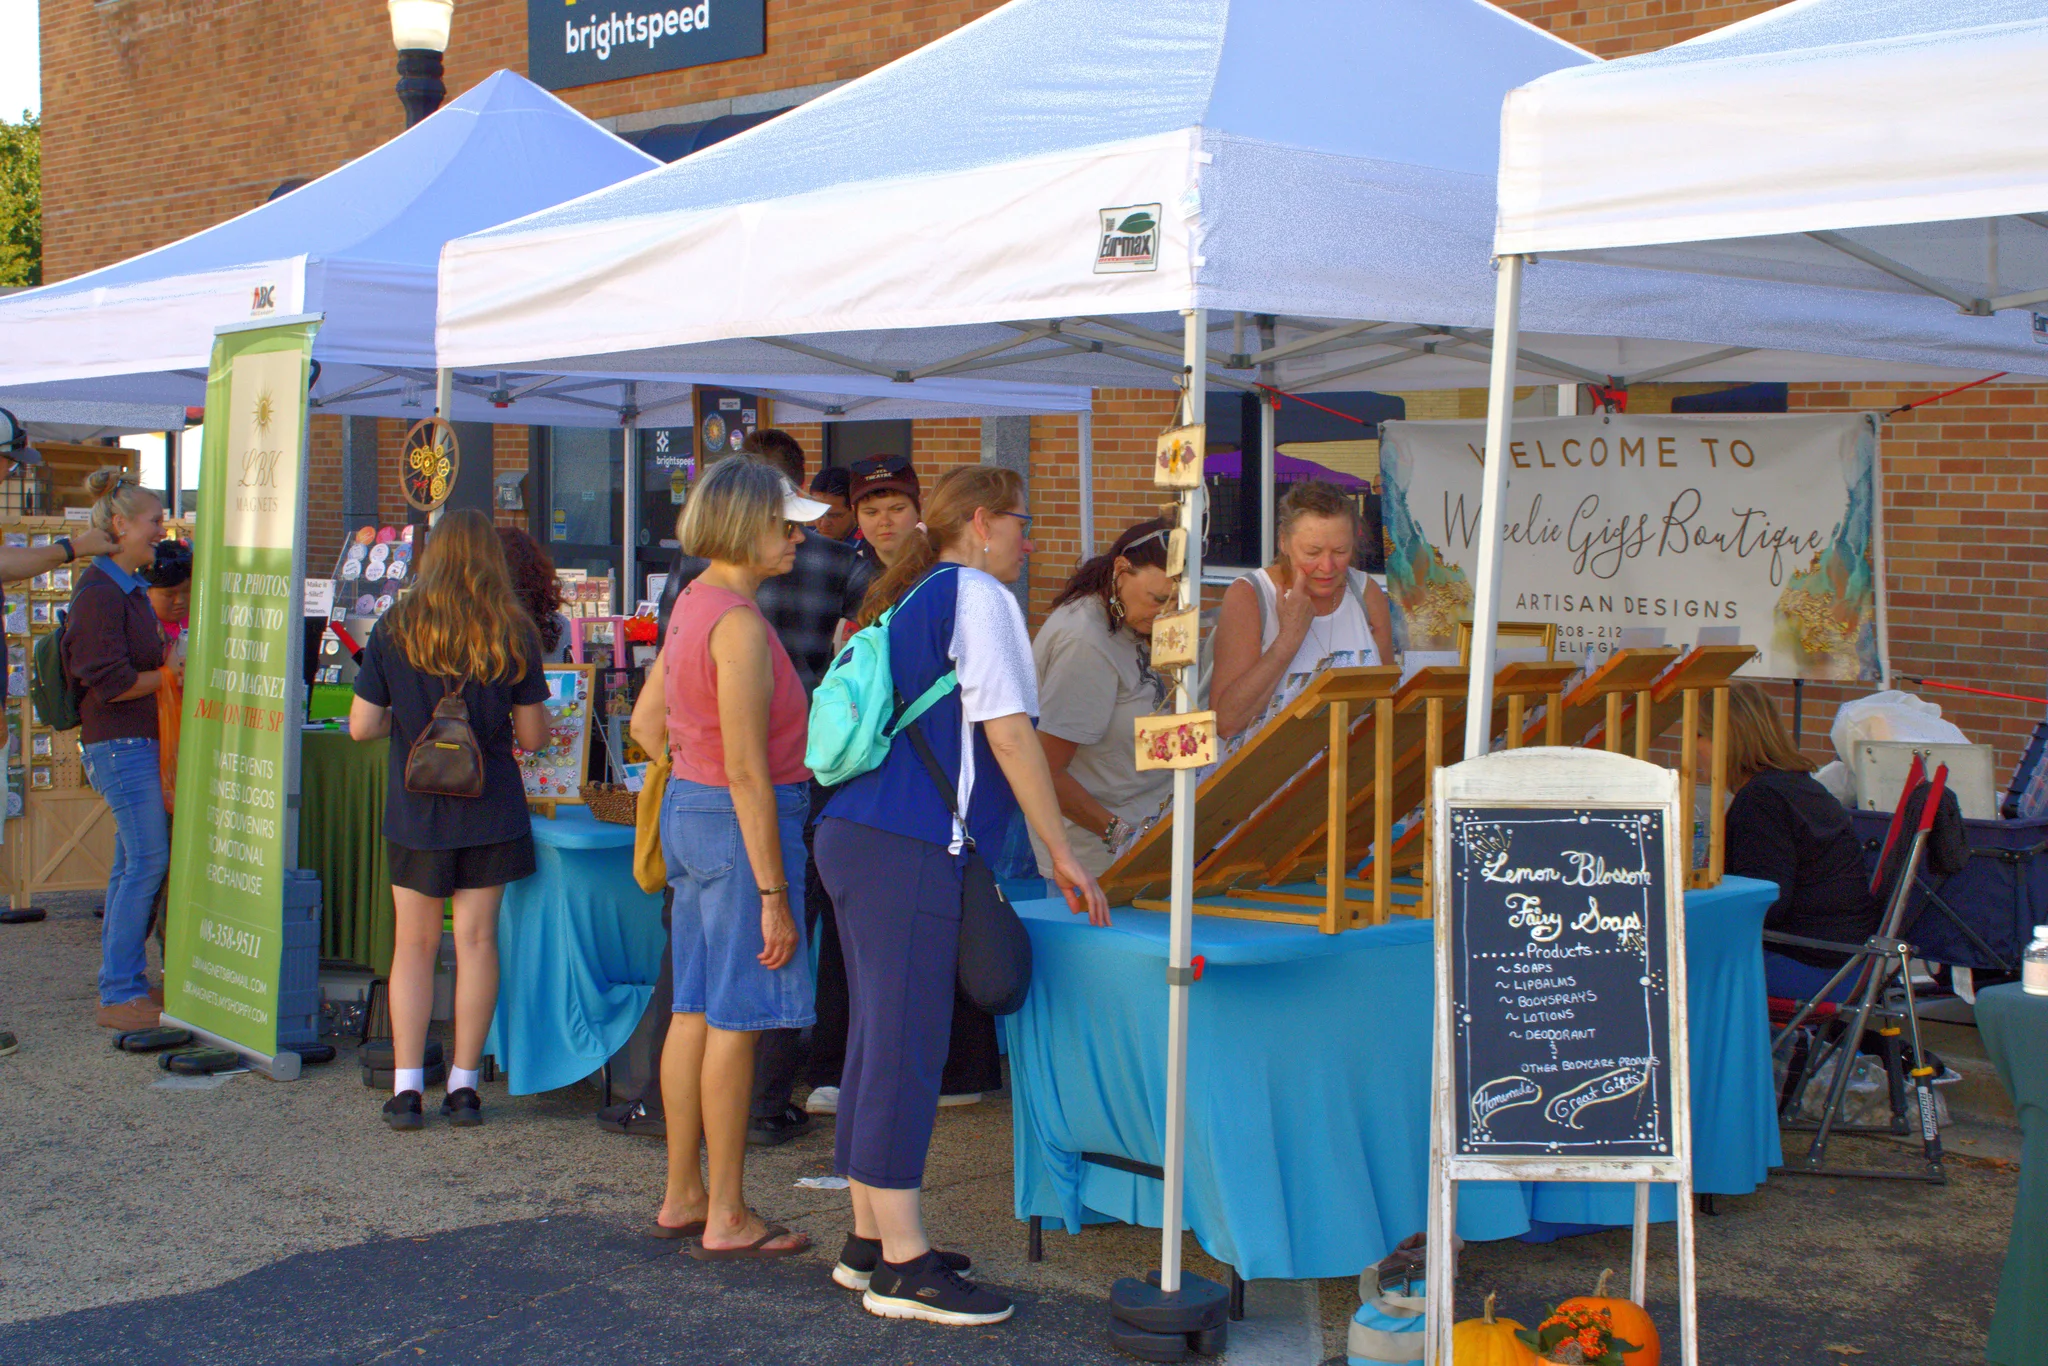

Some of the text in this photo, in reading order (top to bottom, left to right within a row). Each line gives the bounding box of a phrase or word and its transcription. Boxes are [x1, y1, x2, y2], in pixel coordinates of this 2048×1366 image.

[566, 0, 710, 60] brightspeed
[1700, 437, 1756, 468] TO
[235, 497, 279, 512] MAGNETS
[1443, 487, 1562, 549] Weelie
[1657, 488, 1823, 587] Boutique
[255, 607, 284, 630] INTO
[1515, 593, 1738, 619] ARTISAN DESIGNS
[224, 637, 270, 663] CUSTOM
[243, 705, 266, 730] THE
[240, 755, 274, 780] EVENTS
[242, 785, 275, 809] LOGOS
[207, 863, 263, 896] ERCHANDISE
[1481, 850, 1653, 886] Lemon Blossom
[1505, 893, 1642, 945] Fairy Soaps
[1526, 942, 1593, 959] Products
[1513, 963, 1554, 974] SOAPS
[1513, 976, 1577, 990] LIPBALMS
[1518, 990, 1598, 1008] BODYSPRAYS
[1523, 1009, 1575, 1023] LOTIONS
[1525, 1028, 1597, 1041] DEODORANT
[1521, 1062, 1558, 1073] OTHER
[1562, 1057, 1616, 1072] BODYCARE
[1474, 1082, 1536, 1116] Homemade
[1555, 1073, 1641, 1118] Great Gifts
[1919, 1092, 1934, 1135] ROCKER
